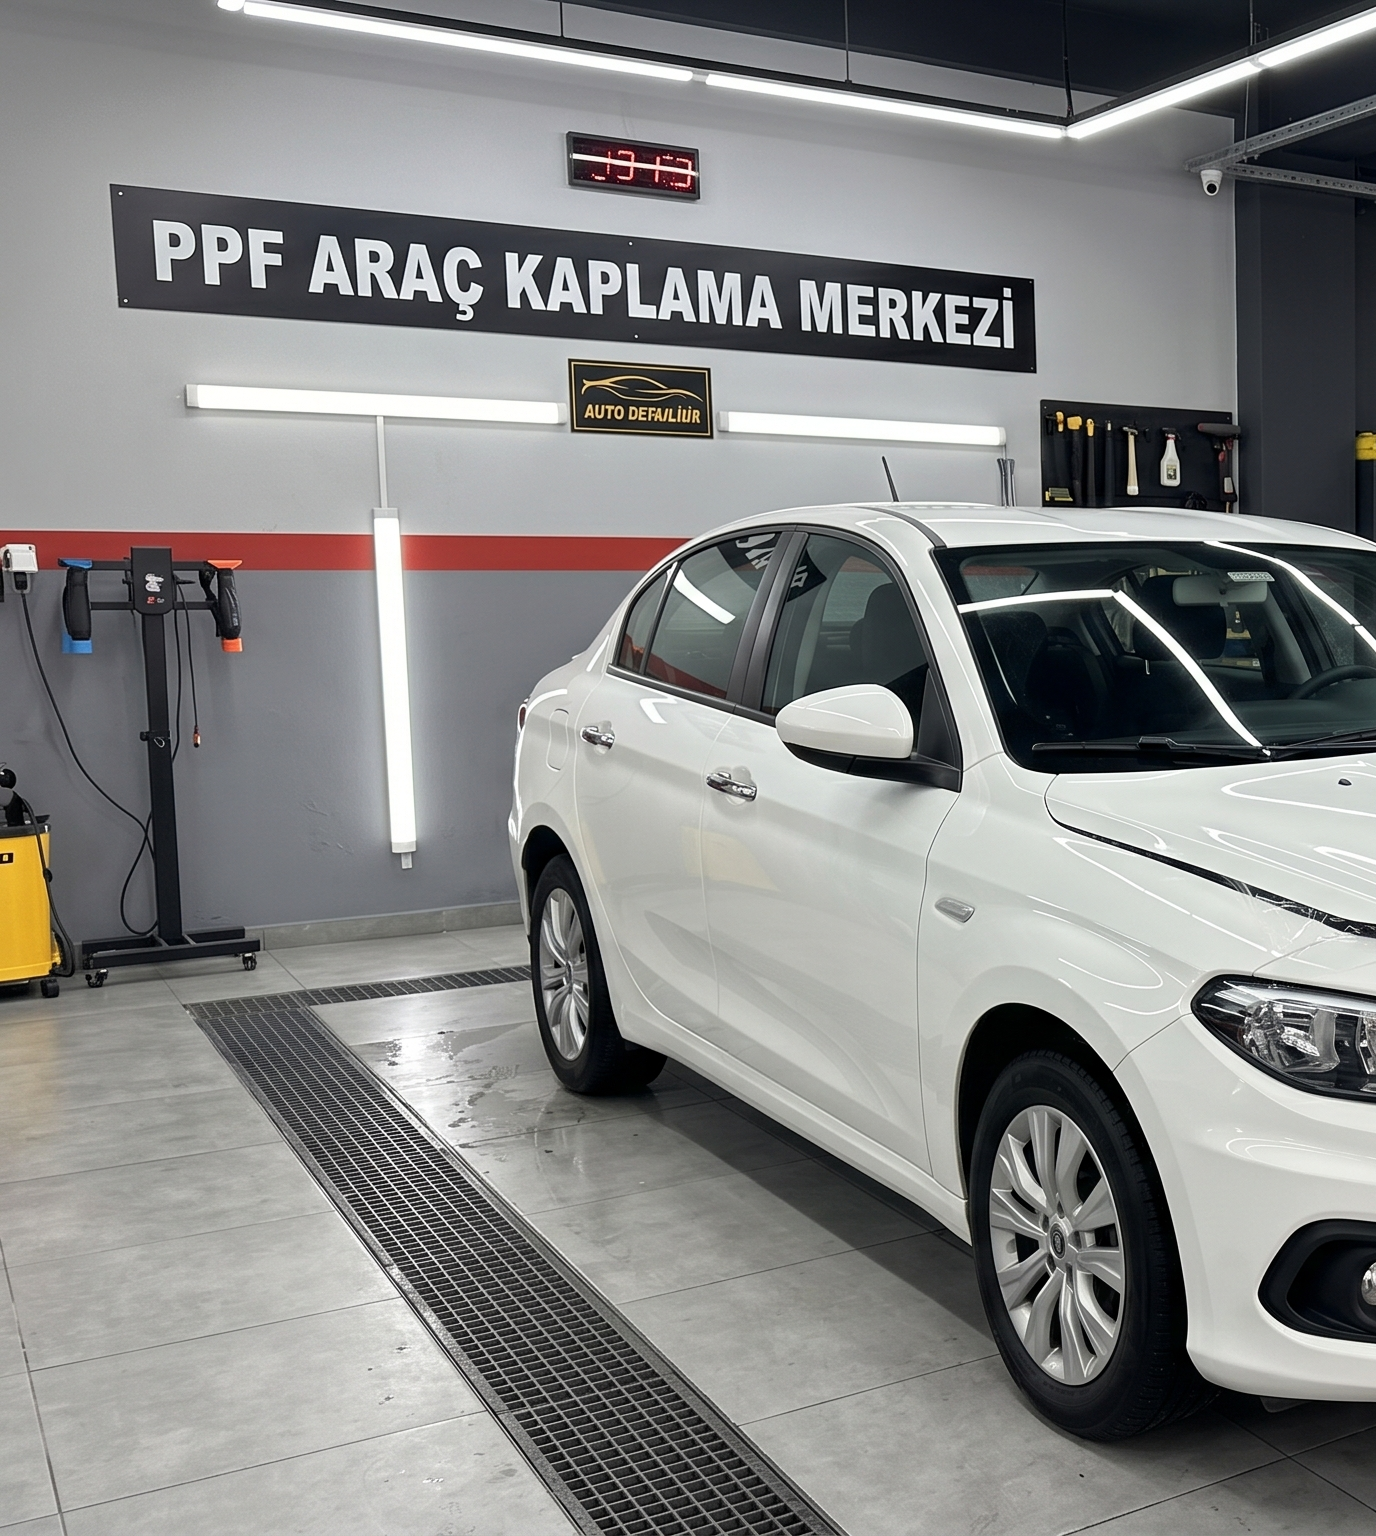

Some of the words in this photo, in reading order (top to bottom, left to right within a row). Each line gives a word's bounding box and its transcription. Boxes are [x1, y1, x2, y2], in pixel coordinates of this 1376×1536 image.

[152, 219, 284, 290] PPF
[308, 235, 484, 321] ARAÇ
[504, 251, 783, 330] KAPLAMA
[800, 279, 1015, 350] MERKEZİ
[584, 404, 625, 420] AUTO
